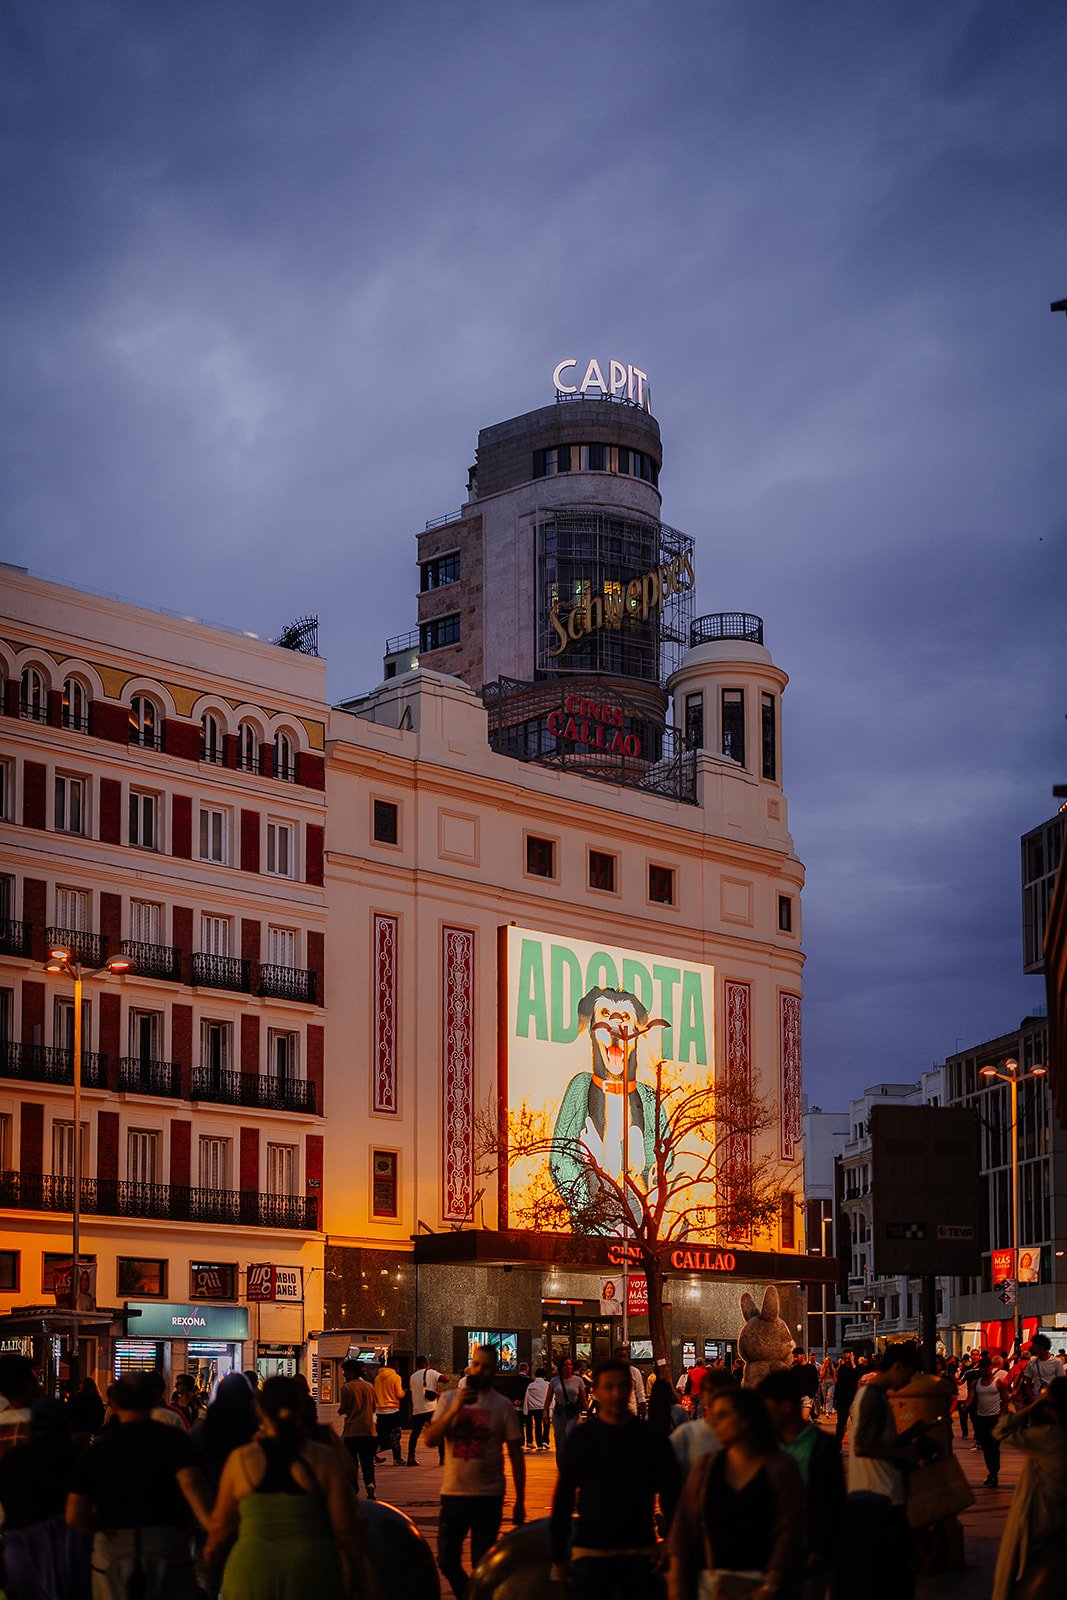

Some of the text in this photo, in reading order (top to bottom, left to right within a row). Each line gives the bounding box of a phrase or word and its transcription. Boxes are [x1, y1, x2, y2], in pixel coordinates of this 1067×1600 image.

[548, 547, 695, 657] Schweppes
[566, 694, 624, 728] CINES
[547, 710, 641, 758] CALLAO
[607, 1245, 736, 1271] CIN CALLAO
[629, 1287, 649, 1299] MÁS
[630, 1280, 648, 1289] VOTA
[171, 1316, 207, 1327] REXONA
